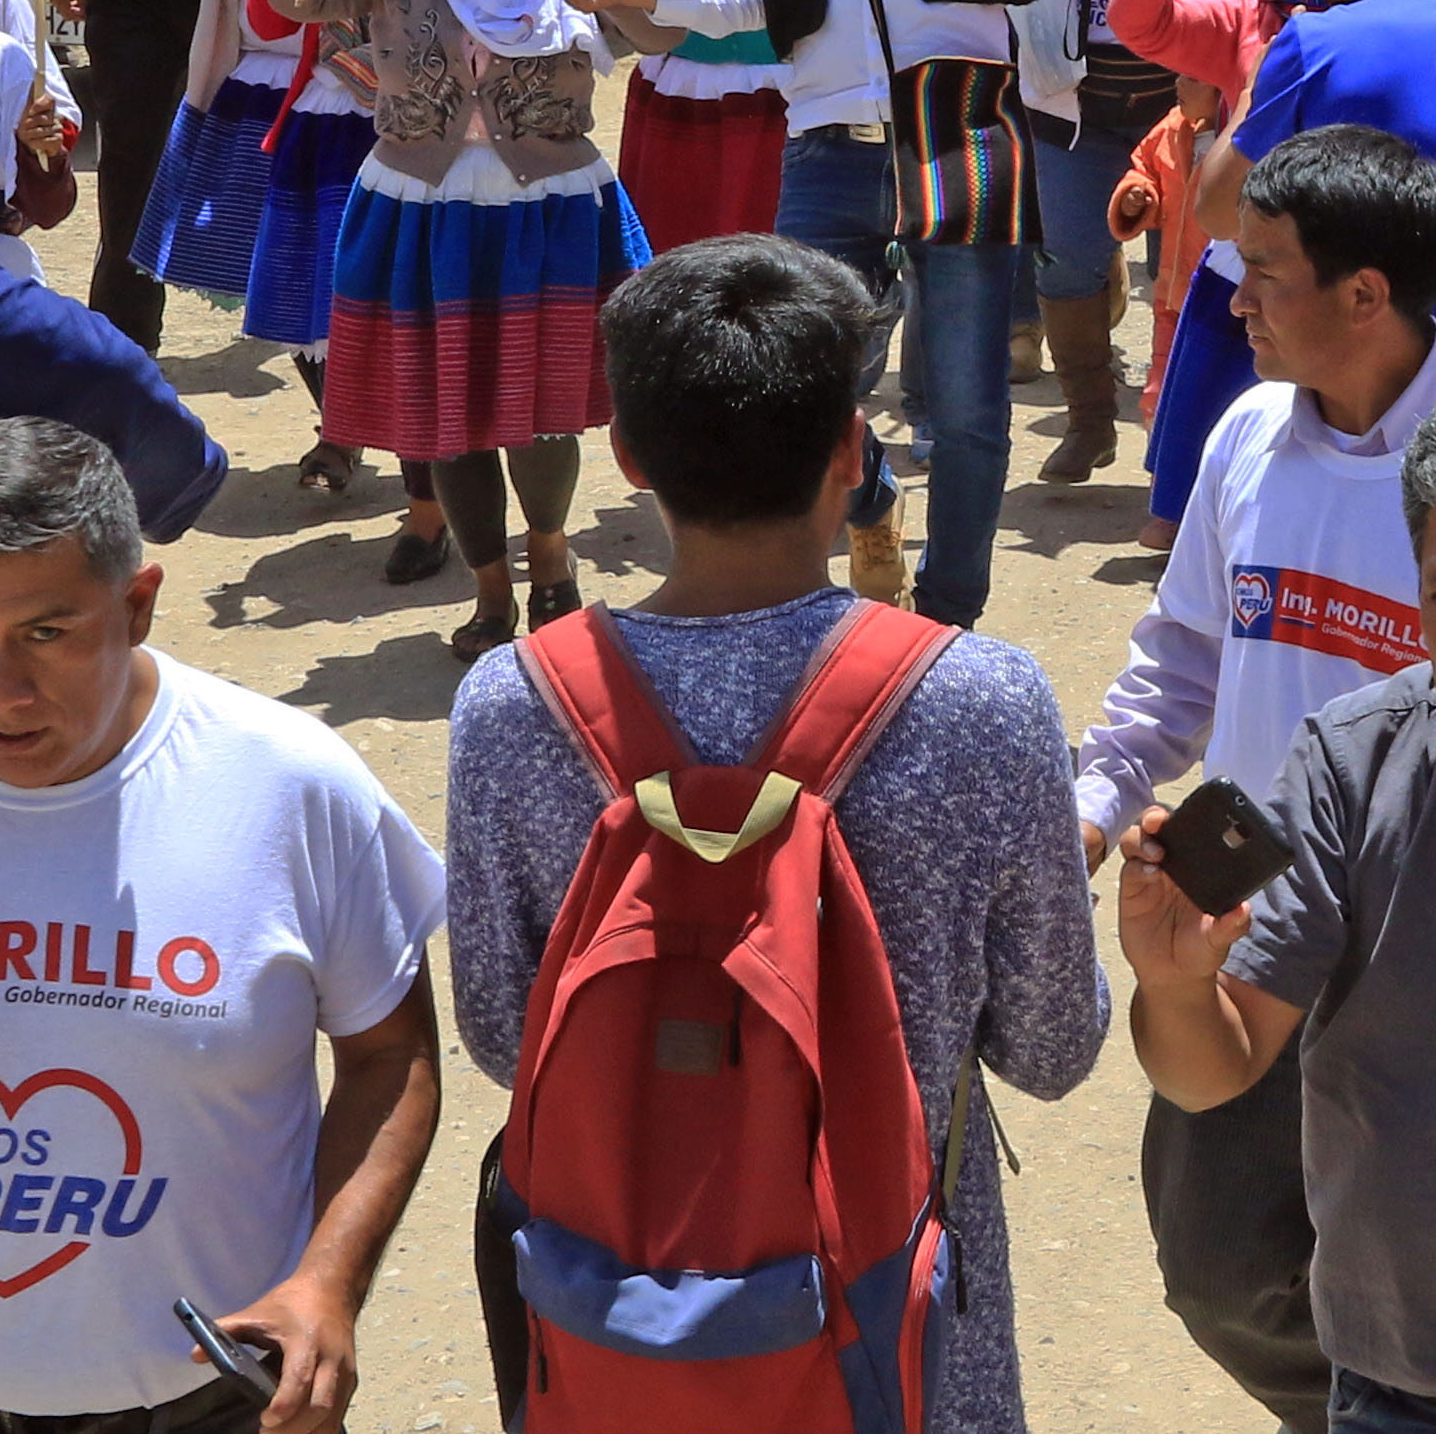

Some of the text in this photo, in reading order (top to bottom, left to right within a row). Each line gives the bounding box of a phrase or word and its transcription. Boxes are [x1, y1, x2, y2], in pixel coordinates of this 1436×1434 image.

[1239, 597, 1273, 613] PERU
[3, 984, 229, 1021] Gobernador Regional
